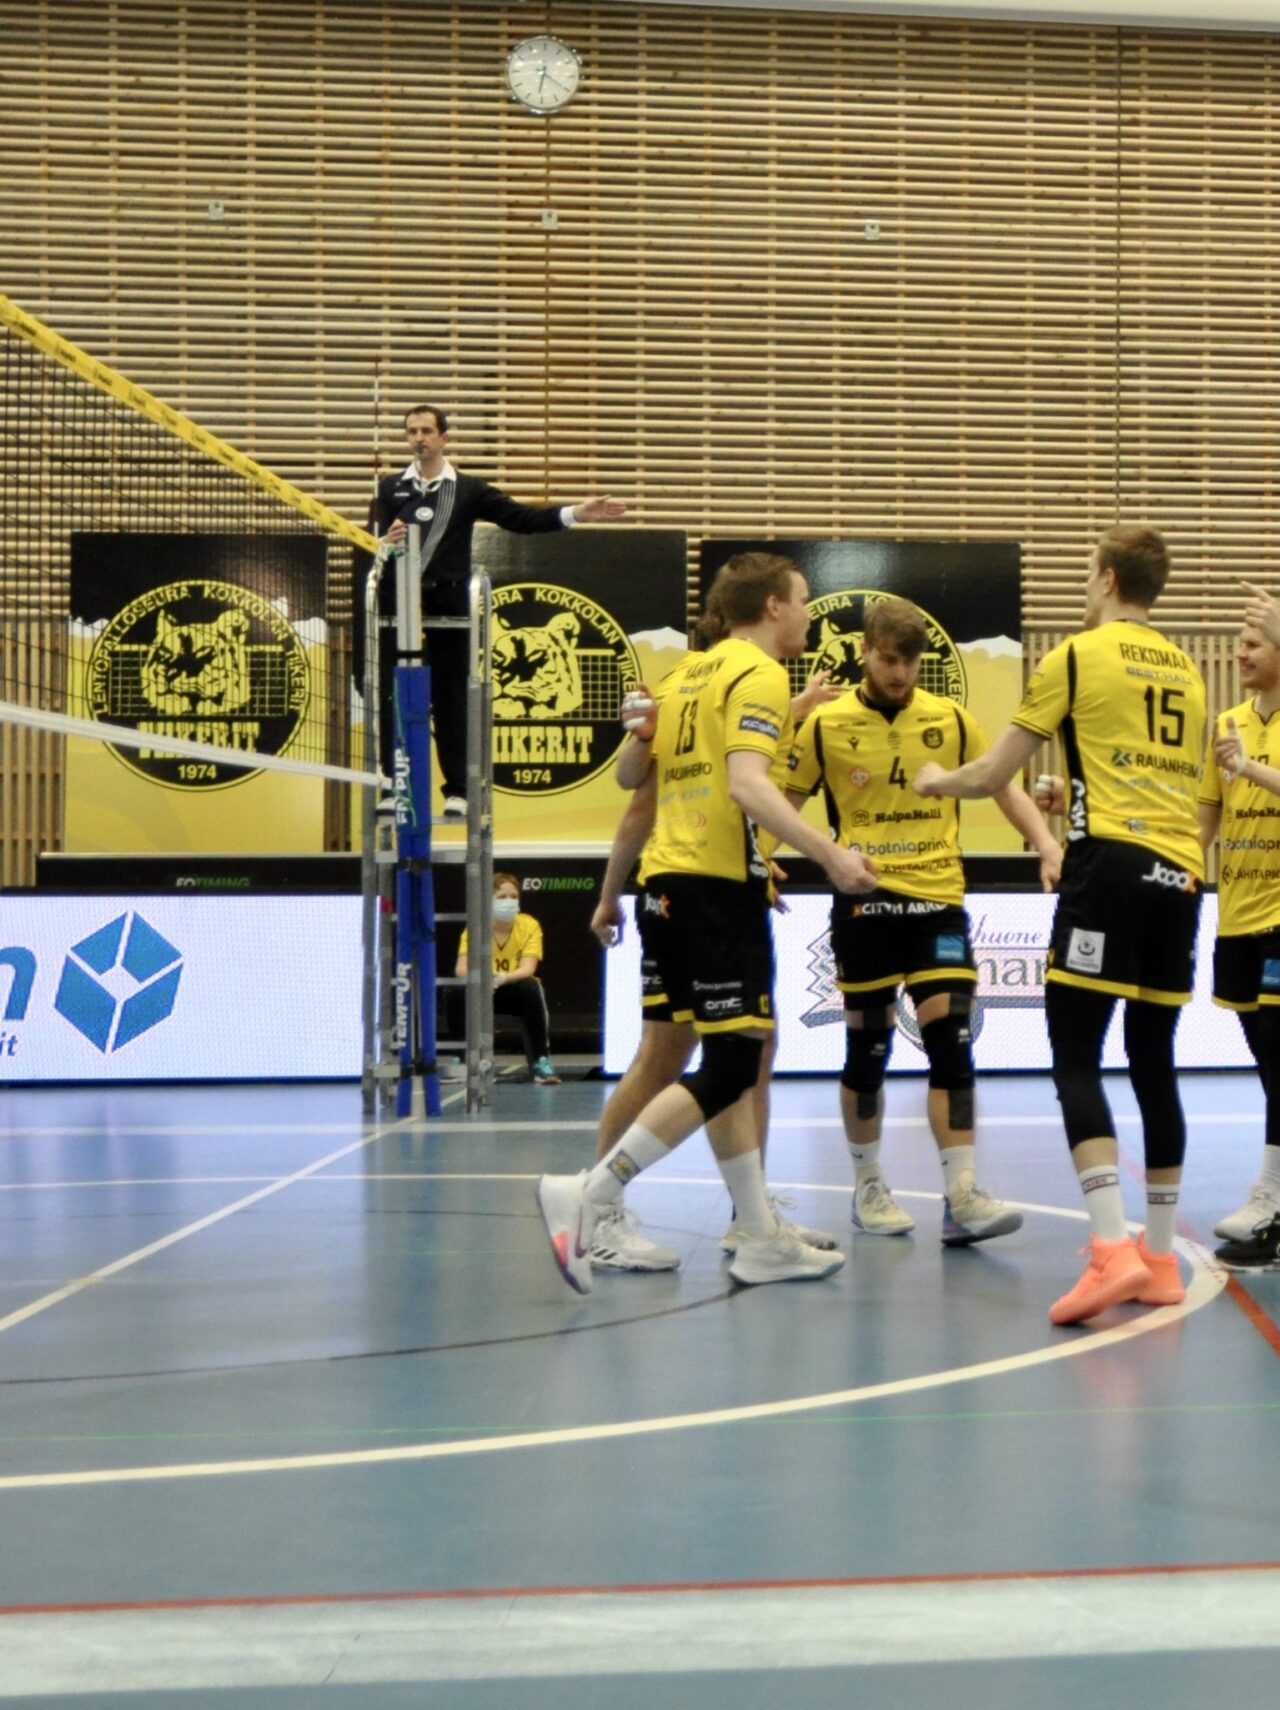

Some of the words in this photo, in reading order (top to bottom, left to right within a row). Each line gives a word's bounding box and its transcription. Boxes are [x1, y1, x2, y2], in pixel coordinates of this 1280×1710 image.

[535, 587, 620, 645] KOKKOLAN
[1119, 642, 1190, 673] REKOMAA
[1143, 684, 1186, 748] 15
[177, 764, 218, 779] 1974
[513, 769, 552, 784] 1974
[887, 755, 908, 790] 4
[522, 877, 596, 891] EOTIMING
